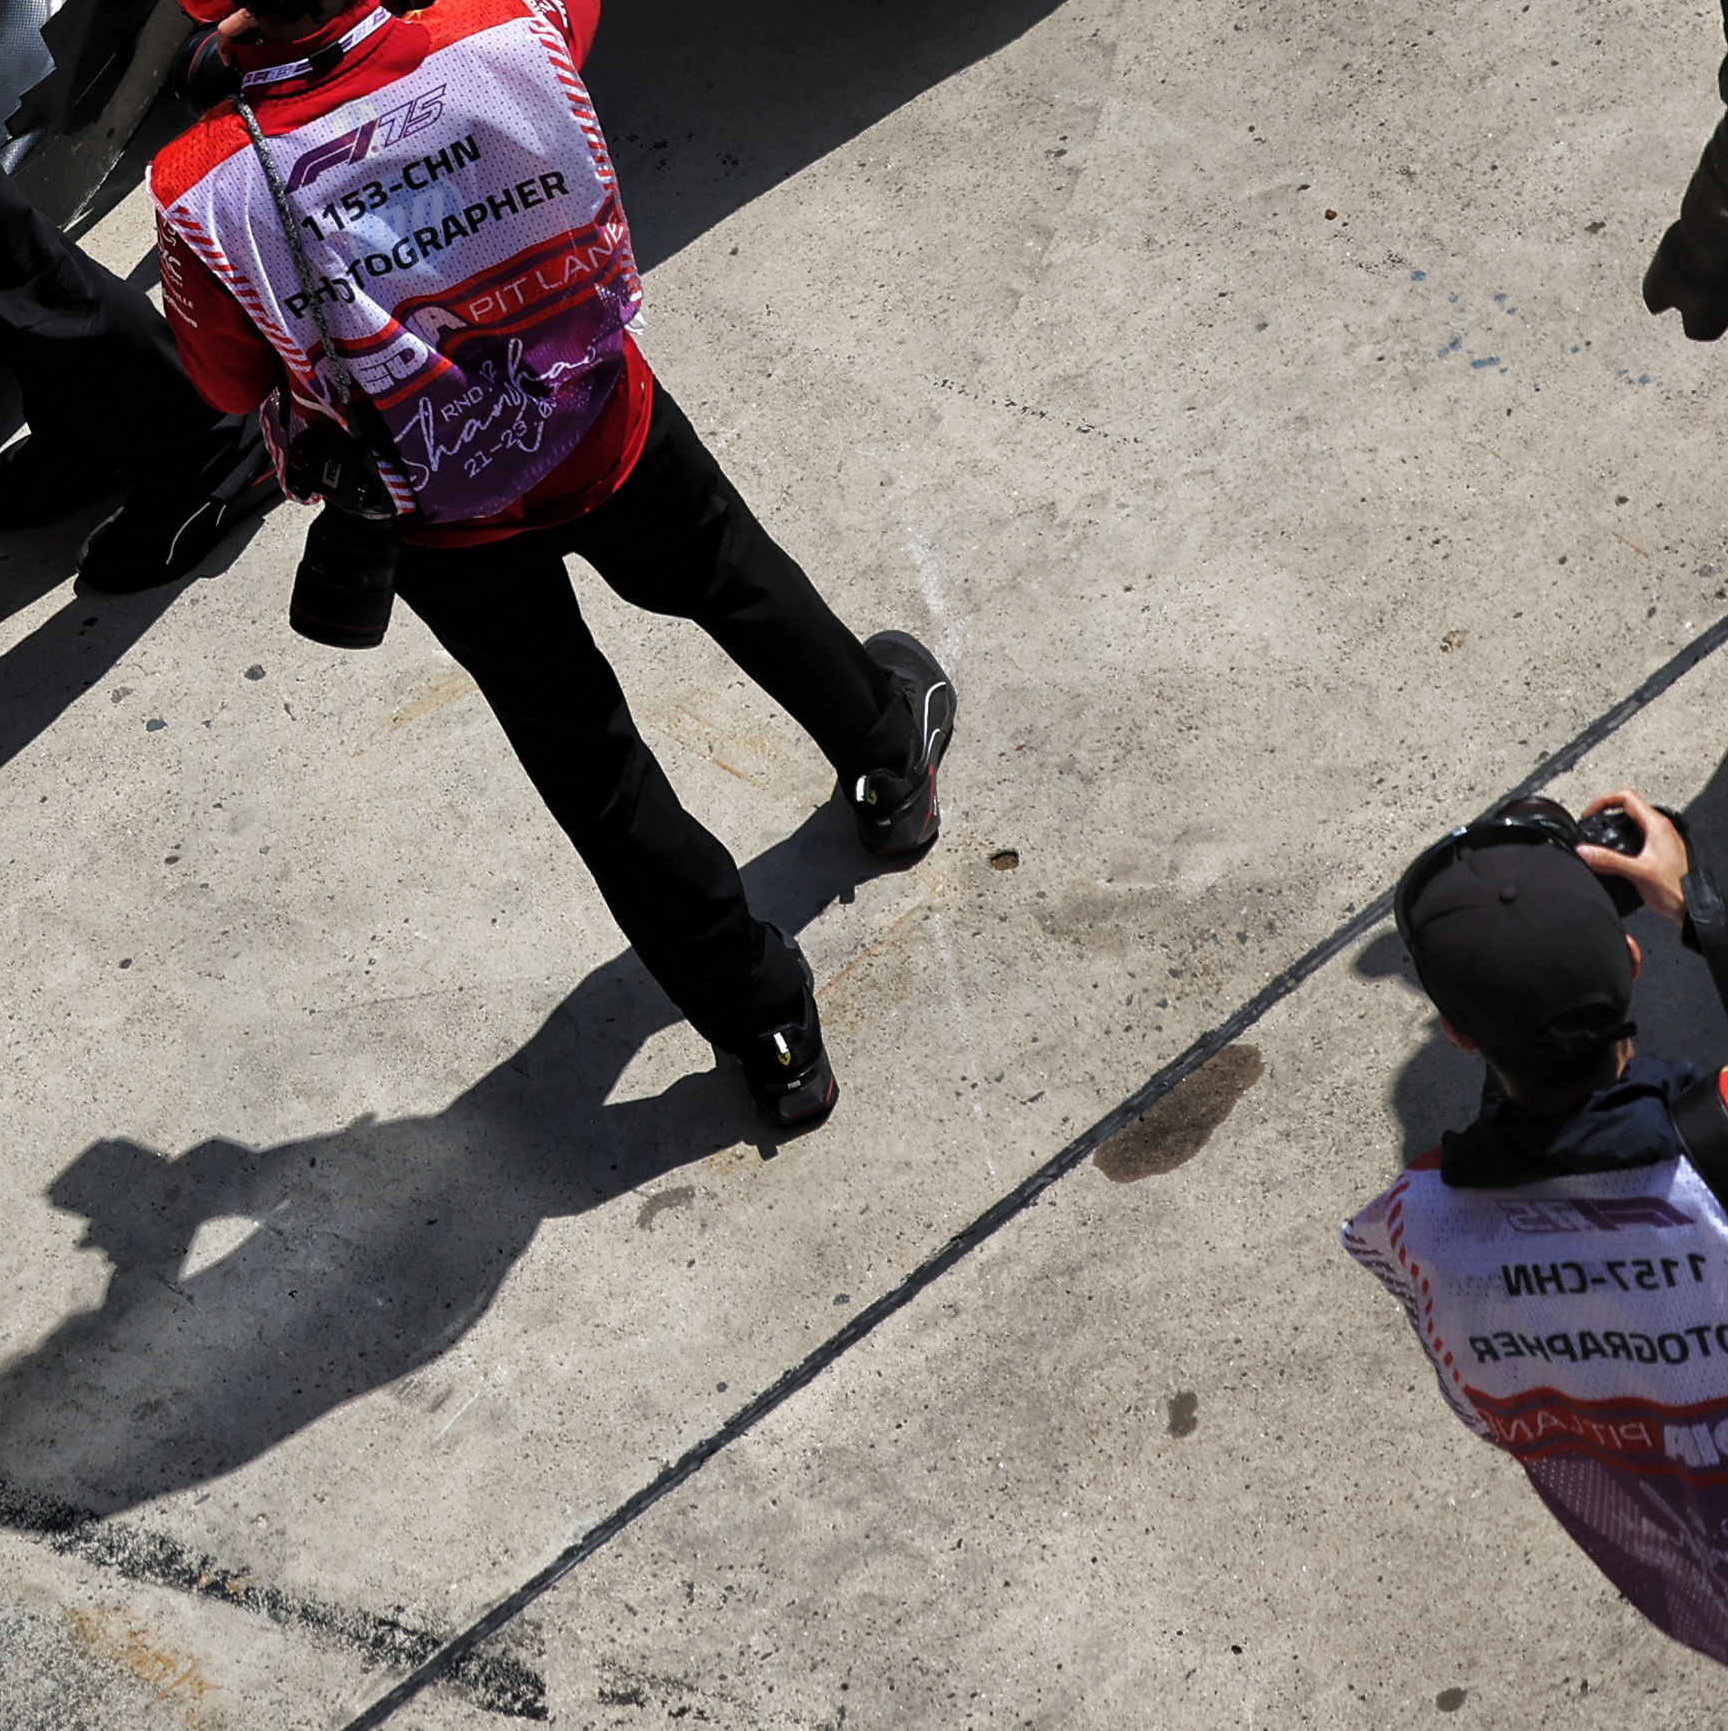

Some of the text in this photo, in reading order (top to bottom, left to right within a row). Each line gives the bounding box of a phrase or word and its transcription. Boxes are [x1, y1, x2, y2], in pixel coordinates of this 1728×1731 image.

[301, 133, 482, 243] 1153-CHN
[468, 221, 624, 323] PIT LANE
